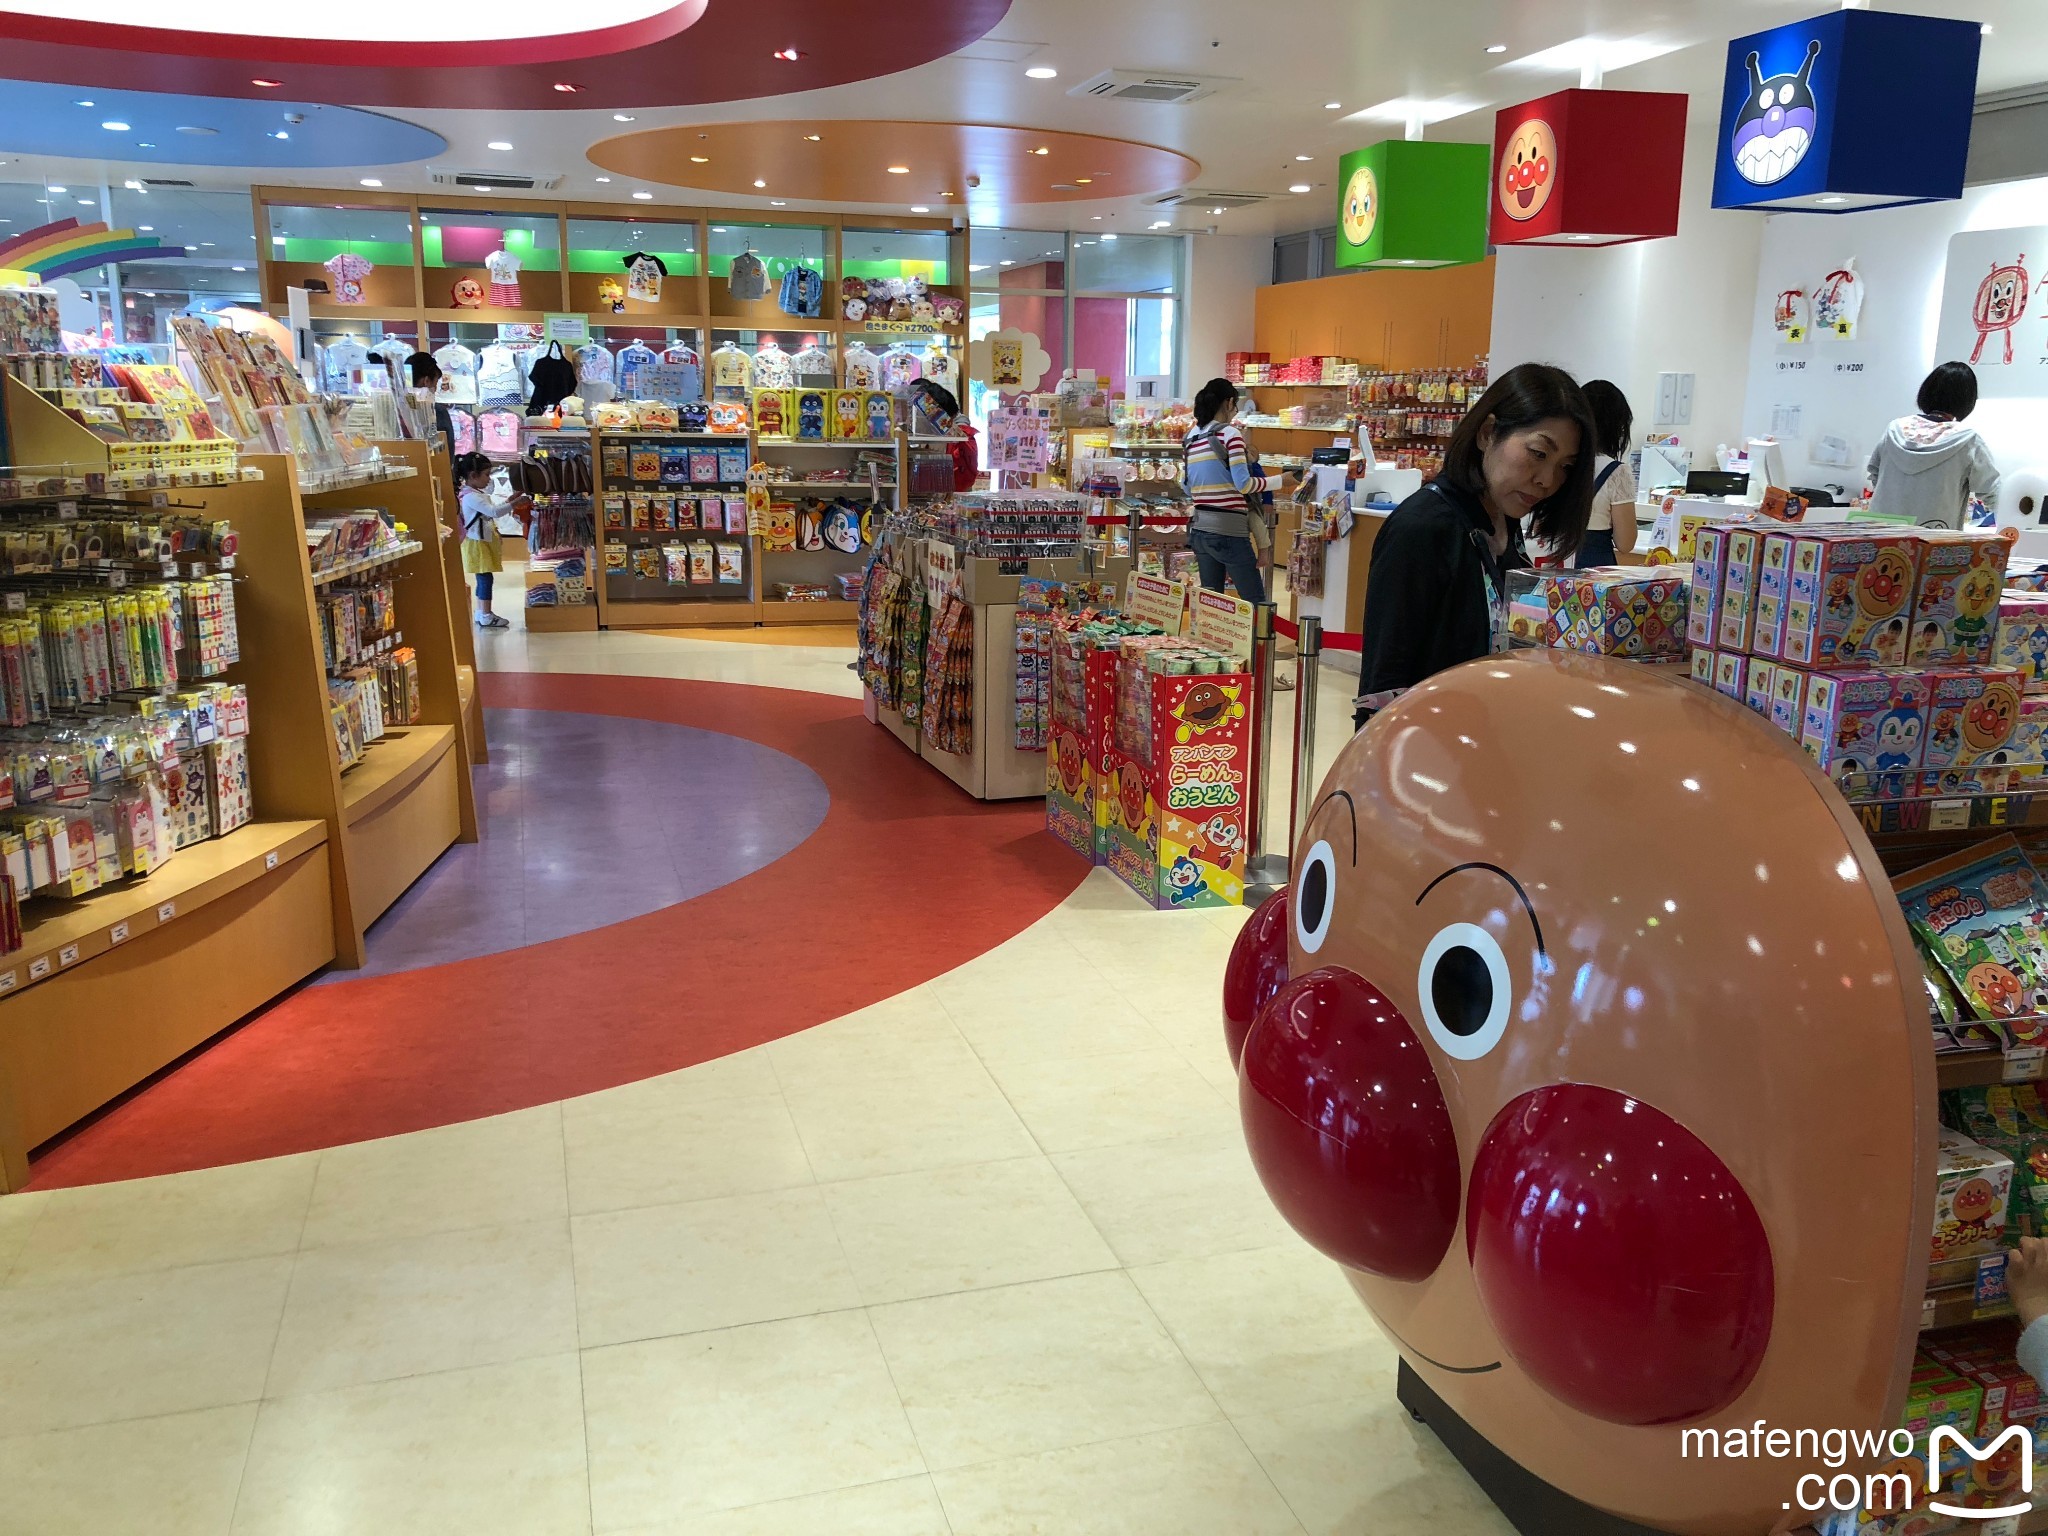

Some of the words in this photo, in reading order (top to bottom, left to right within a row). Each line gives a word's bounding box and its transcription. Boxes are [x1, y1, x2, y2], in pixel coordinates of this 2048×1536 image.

[905, 324, 933, 333] ¥2700
[1171, 745, 1237, 762] アンパンマン
[1169, 785, 1240, 808] おうどん
[1861, 801, 1926, 832] NEW
[1970, 794, 2034, 827] NEW
[1925, 896, 1986, 935] 焼きのり
